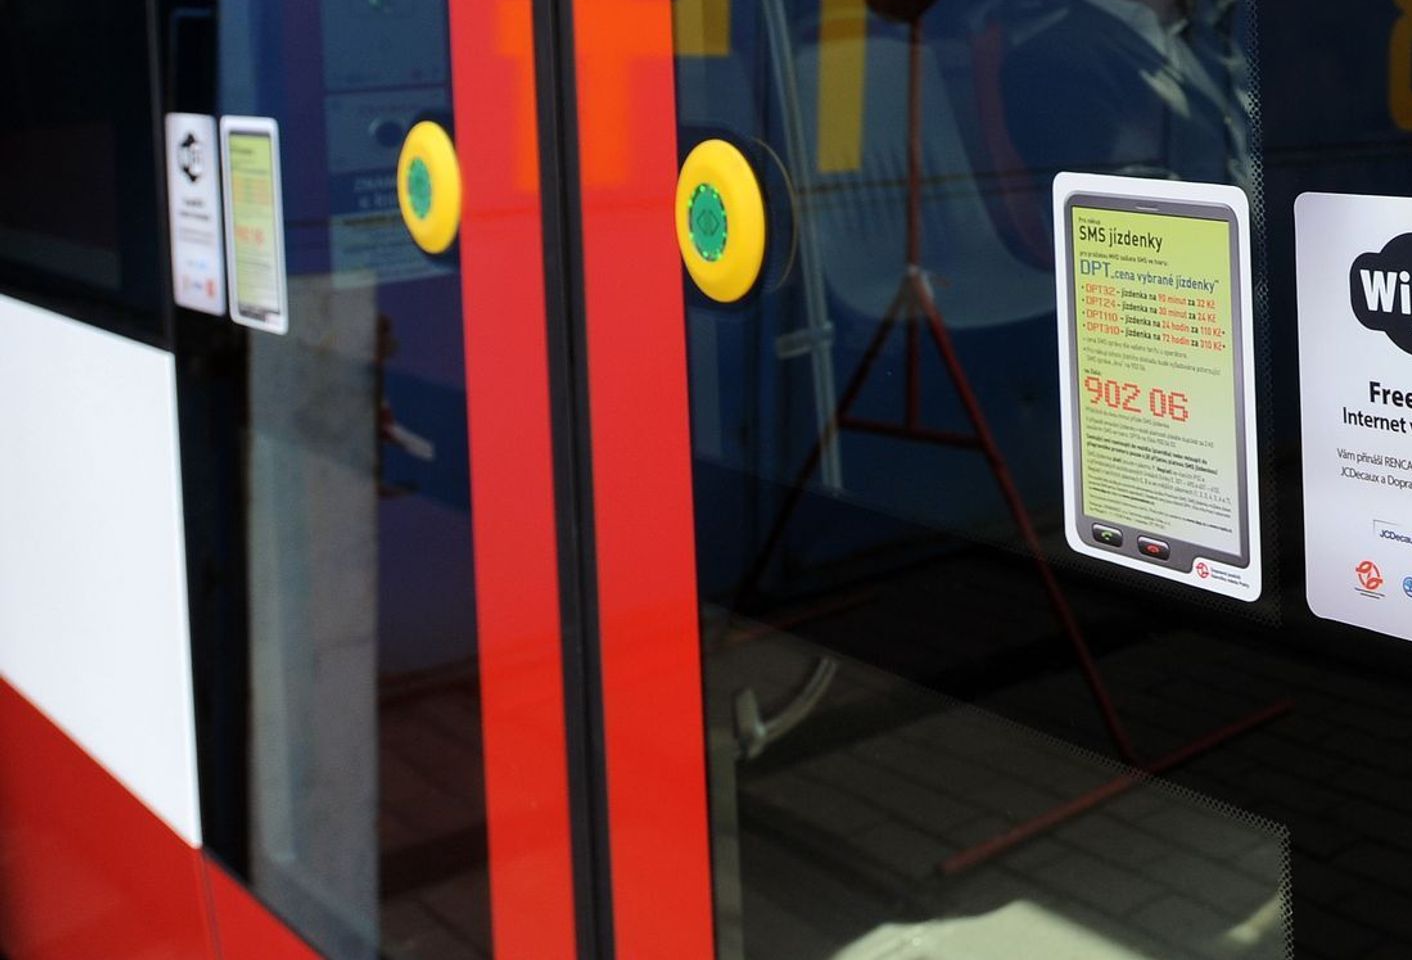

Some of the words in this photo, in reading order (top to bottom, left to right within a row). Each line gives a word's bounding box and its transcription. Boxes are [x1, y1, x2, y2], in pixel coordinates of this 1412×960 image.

[1080, 226, 1106, 242] SMS
[1109, 228, 1162, 252] jízdenky
[1080, 259, 1111, 277] DPT
[1137, 272, 1173, 286] vybrané
[1191, 326, 1198, 334] za
[1084, 376, 1141, 412] 902
[1150, 388, 1188, 422] 06
[1344, 407, 1406, 433] Internet
[1337, 448, 1355, 460] Vám
[1357, 452, 1382, 465] přináší
[1341, 467, 1379, 482] JCDecaux
[1381, 476, 1386, 484] a
